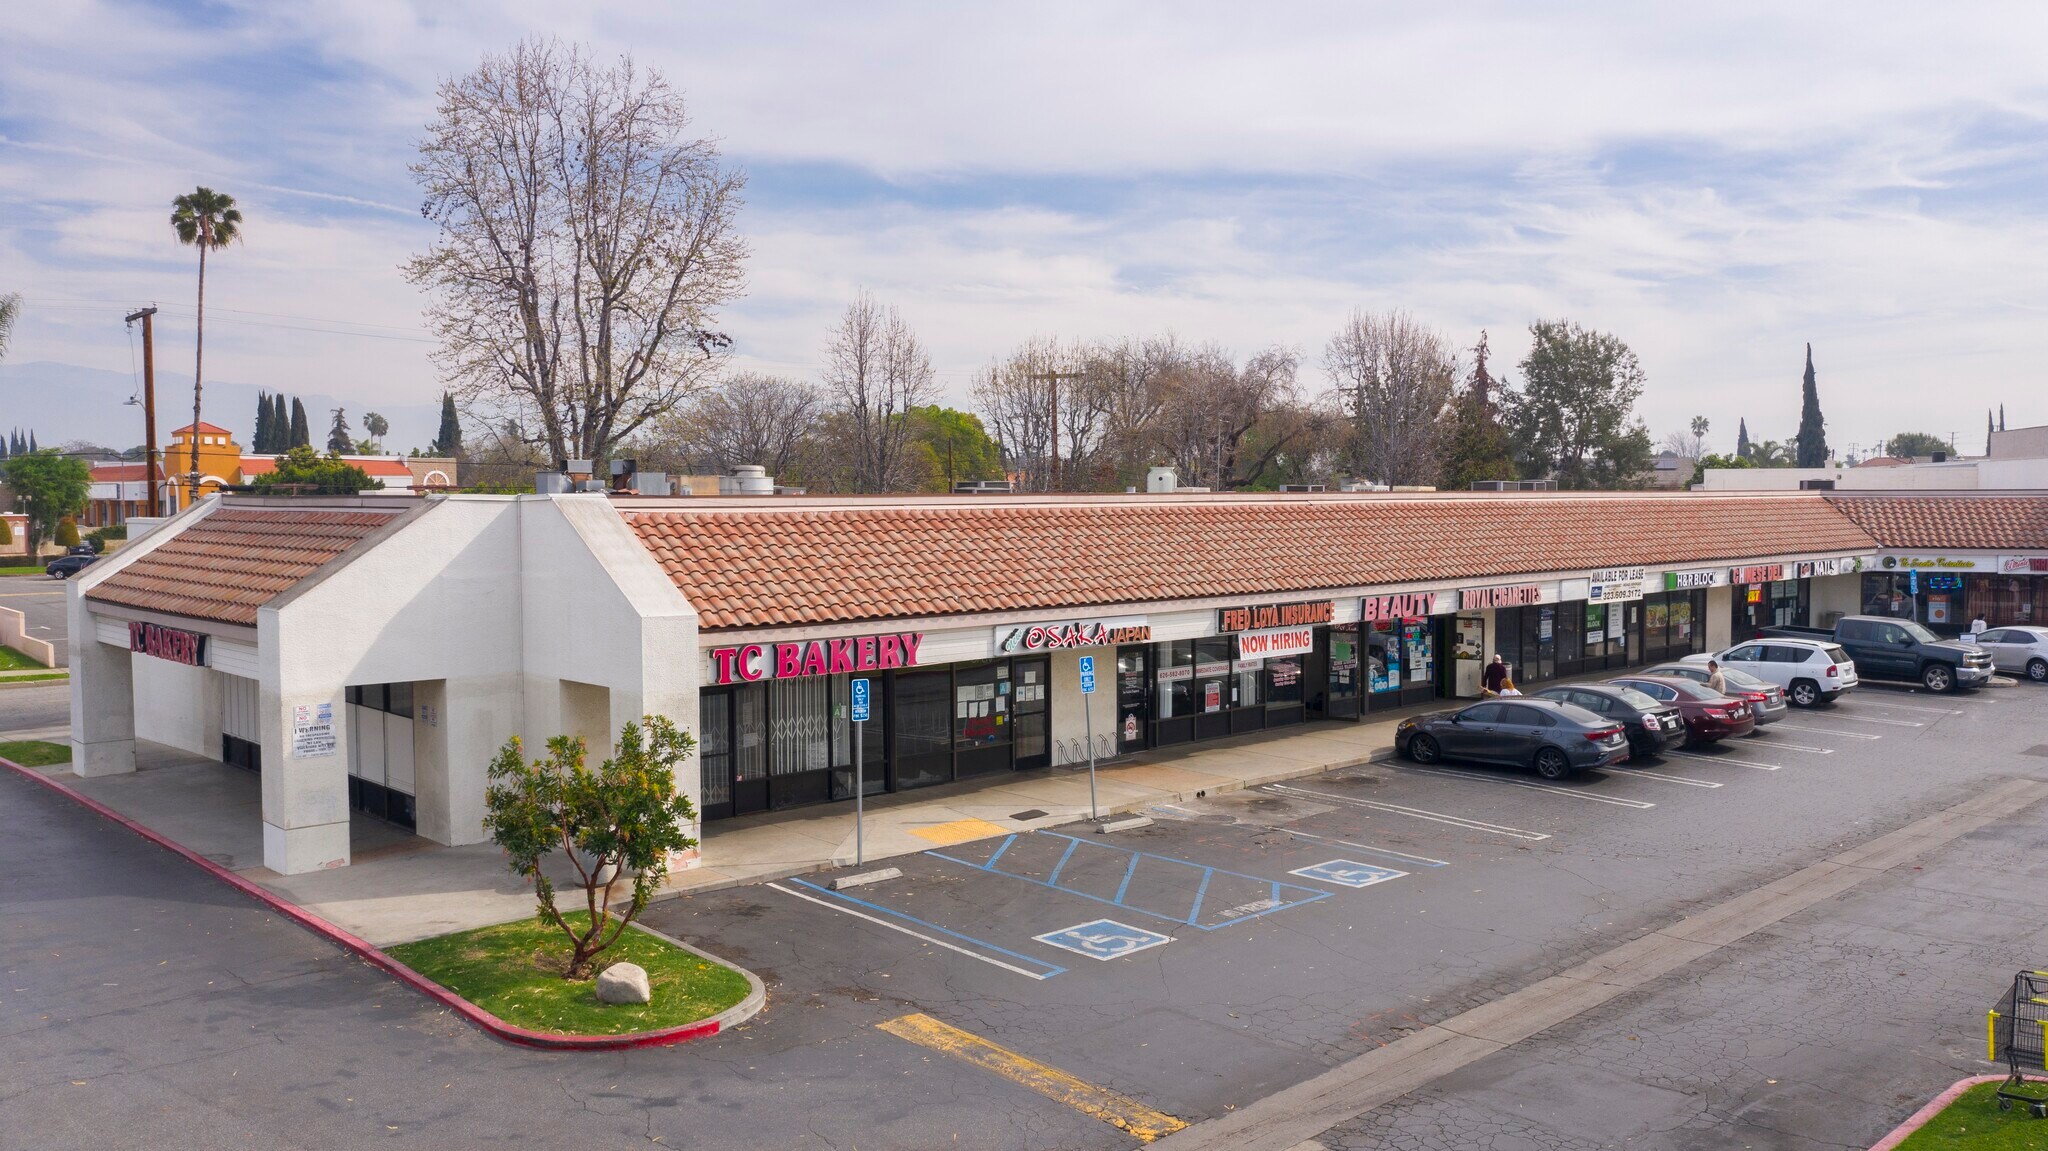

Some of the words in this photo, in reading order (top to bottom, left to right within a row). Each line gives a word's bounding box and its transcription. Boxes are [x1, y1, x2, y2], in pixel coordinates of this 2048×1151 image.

[1591, 571, 1617, 583] AVAILABLE
[1618, 570, 1628, 581] FOR
[1630, 568, 1644, 580] LEASE
[1677, 574, 1693, 588] H&R
[1693, 571, 1718, 586] BLOCK
[1733, 566, 1767, 584] CHINESE
[1767, 564, 1784, 582] DELI
[1814, 560, 1835, 576] NAILS
[1365, 592, 1437, 621] BEAUTY
[1463, 588, 1492, 610] ROYAL
[1493, 583, 1542, 607] CIGARETTES
[1603, 589, 1642, 600] 323.609.3172
[1224, 608, 1251, 632] FRED
[1253, 606, 1279, 629] LOYA
[1281, 602, 1335, 626] INSURANCE
[146, 623, 199, 667] BAKERY
[1026, 622, 1109, 649] OSAKA
[1109, 626, 1152, 644] JAPAN
[1241, 634, 1268, 654] NOW
[1271, 630, 1310, 650] HIRING
[712, 644, 763, 685] TC
[775, 632, 924, 679] BAKERY
